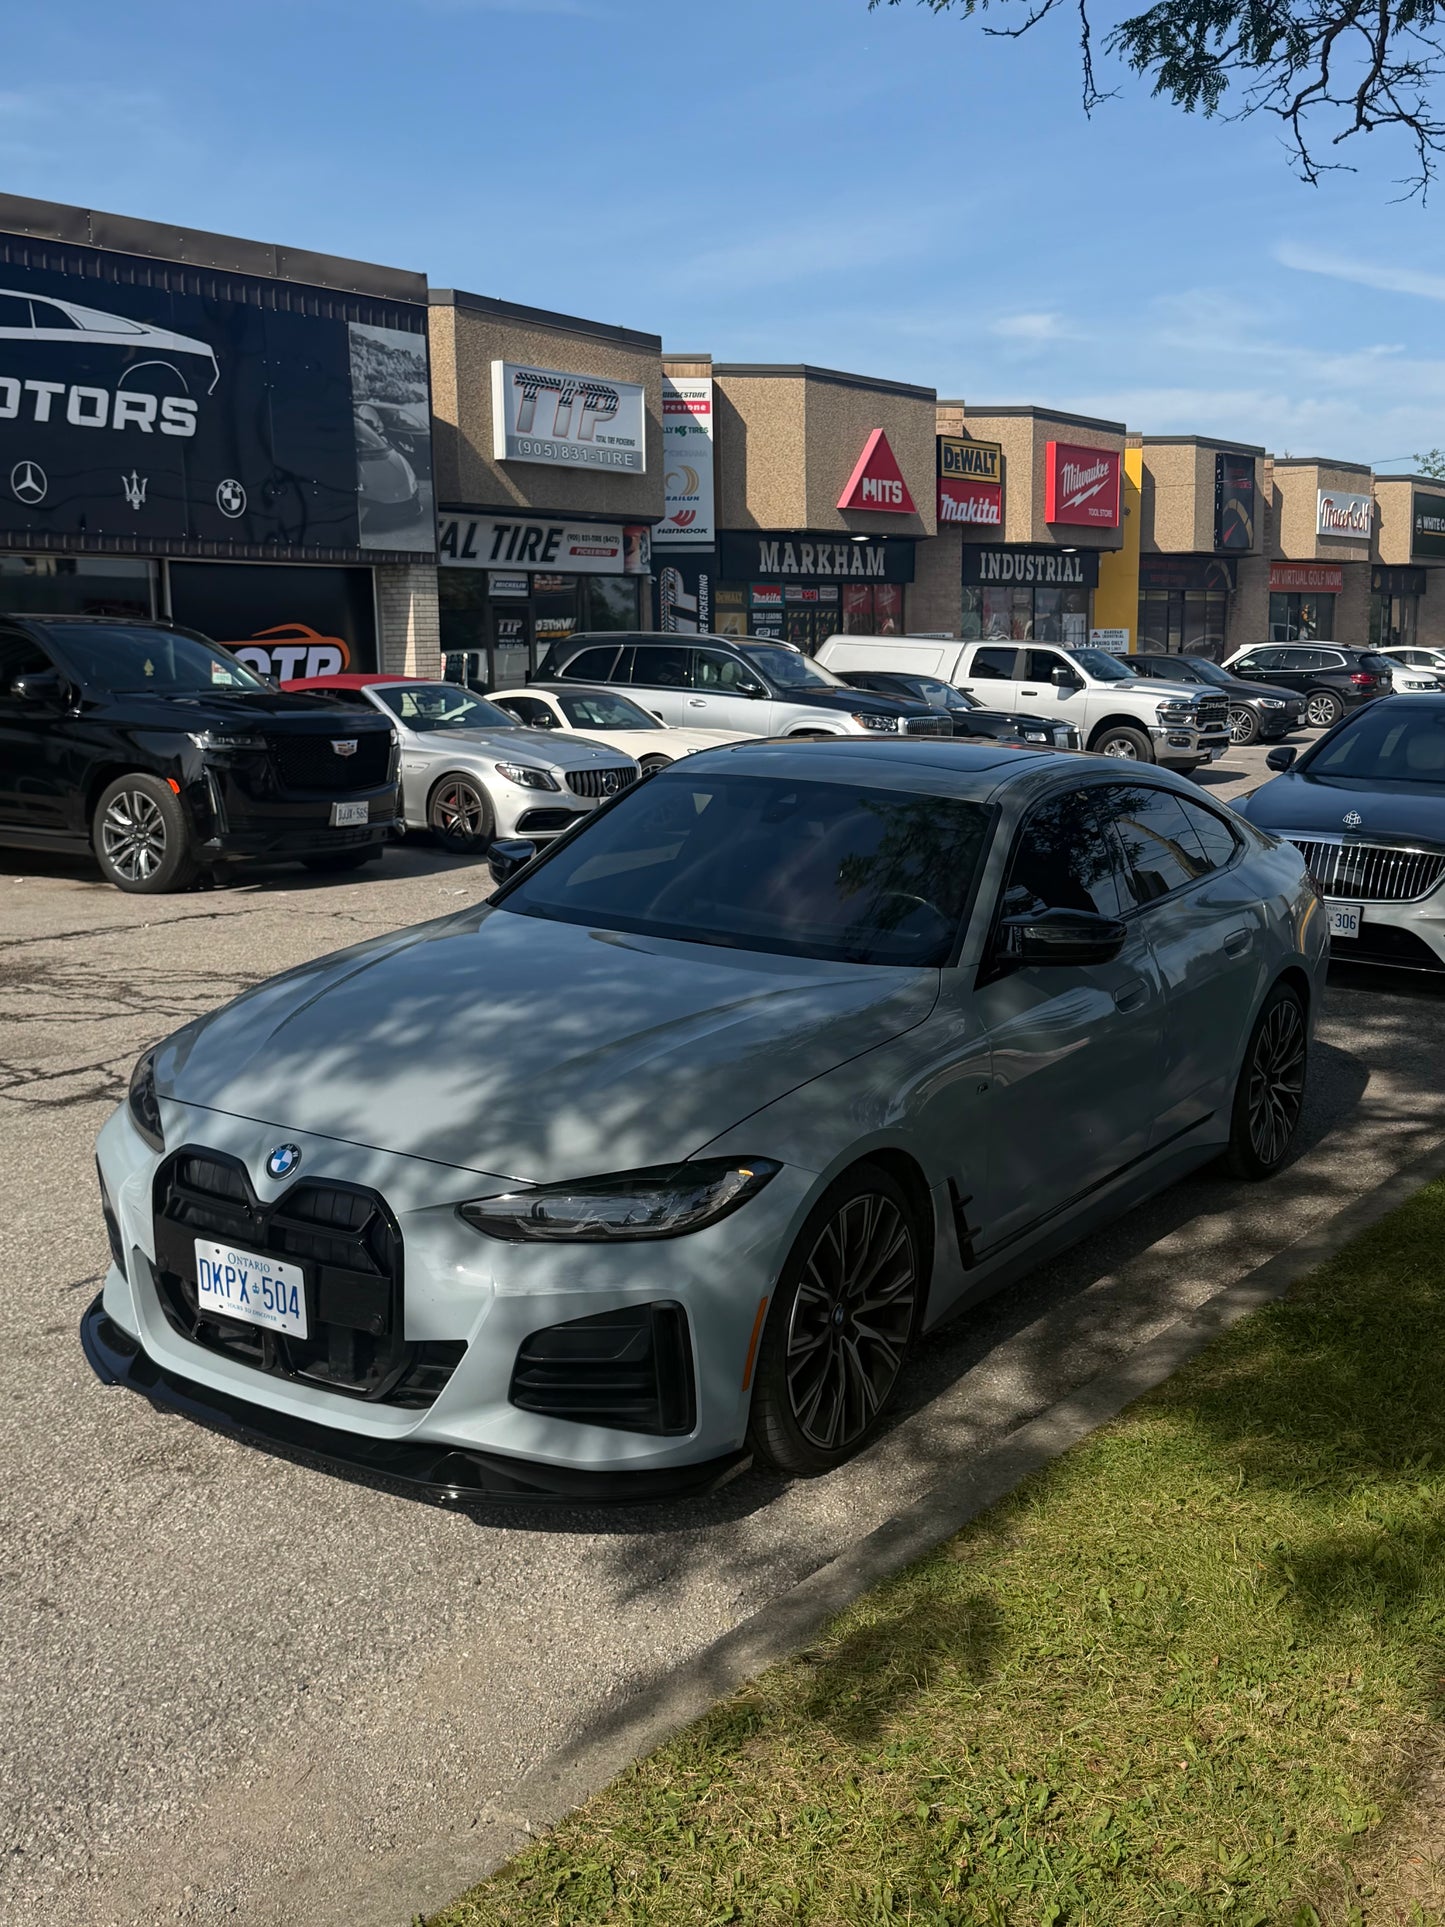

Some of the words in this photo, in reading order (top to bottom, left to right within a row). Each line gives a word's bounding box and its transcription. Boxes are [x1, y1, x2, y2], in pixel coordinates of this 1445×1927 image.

[862, 477, 903, 504] MITS
[1060, 458, 1110, 497] Milwaukee
[1423, 516, 1441, 531] WHITE
[438, 519, 479, 560] AL
[489, 524, 565, 563] TIRE
[759, 541, 886, 576] MARKHAM
[979, 552, 1084, 582] INDUSTRIAL
[495, 581, 527, 589] MICHELIN
[1269, 569, 1280, 585] AY
[1281, 569, 1308, 586] VIRTUAL
[1308, 570, 1325, 587] GOLF
[698, 574, 709, 621] PICKERING
[1335, 912, 1357, 930] 306
[228, 1252, 271, 1273] ONTARIO
[199, 1258, 250, 1304] DKPX
[262, 1276, 300, 1319] 504
